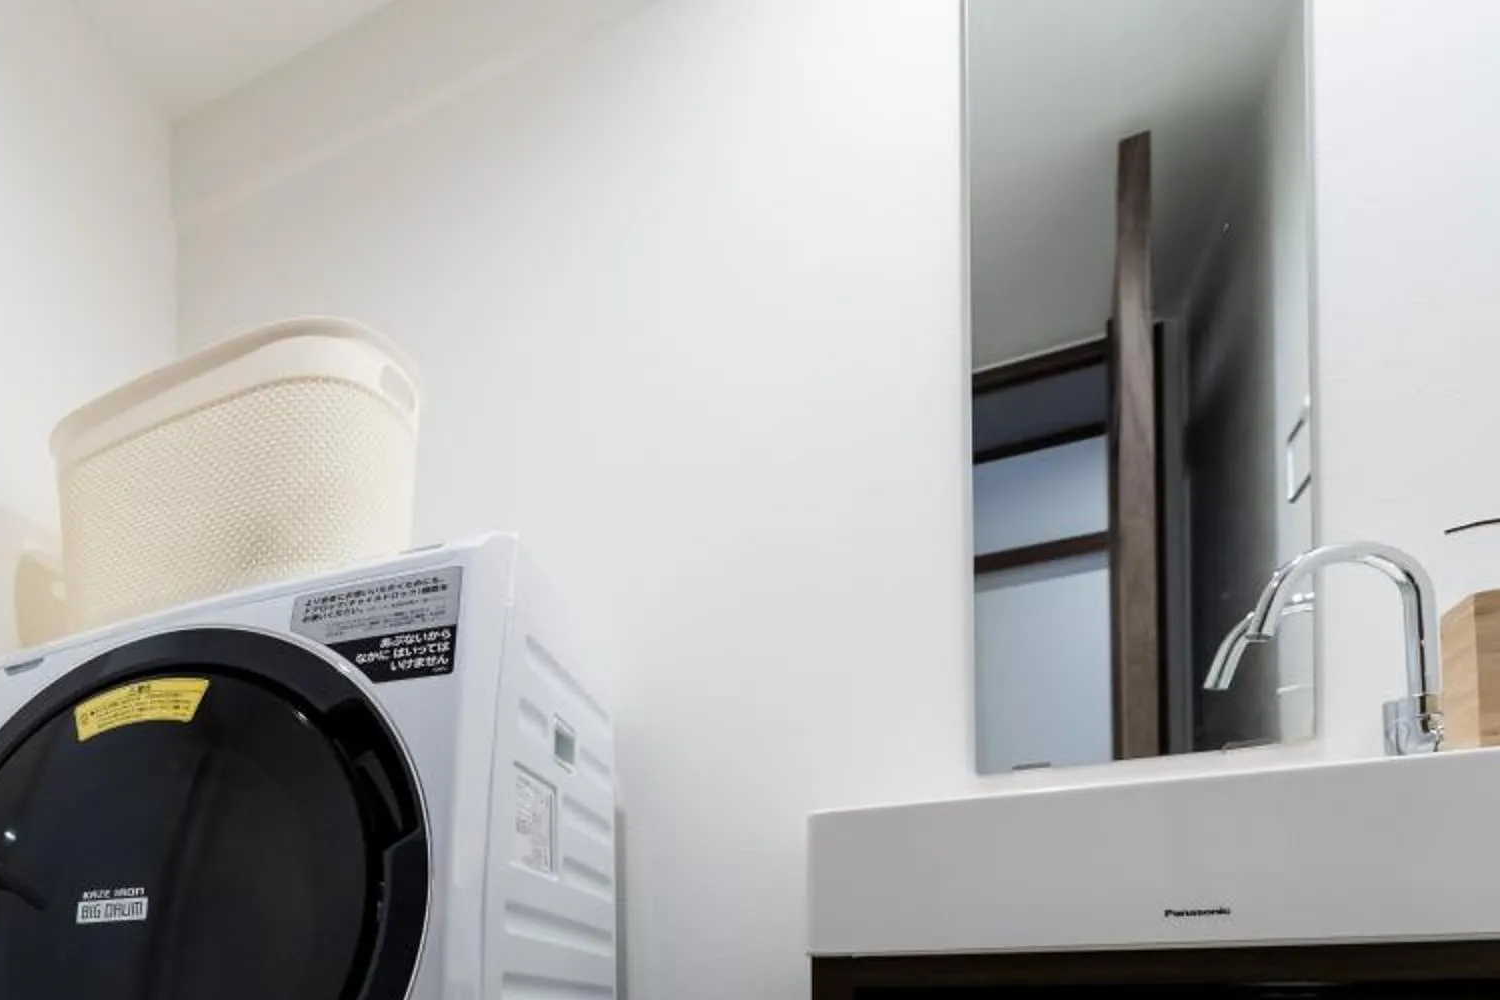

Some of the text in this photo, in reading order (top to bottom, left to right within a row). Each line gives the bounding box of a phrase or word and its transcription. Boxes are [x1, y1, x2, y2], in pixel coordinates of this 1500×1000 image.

[380, 629, 451, 648] あぶないから
[356, 641, 450, 664] なかに はいっては
[390, 654, 449, 671] いけません
[82, 902, 142, 919] BIG DRUM
